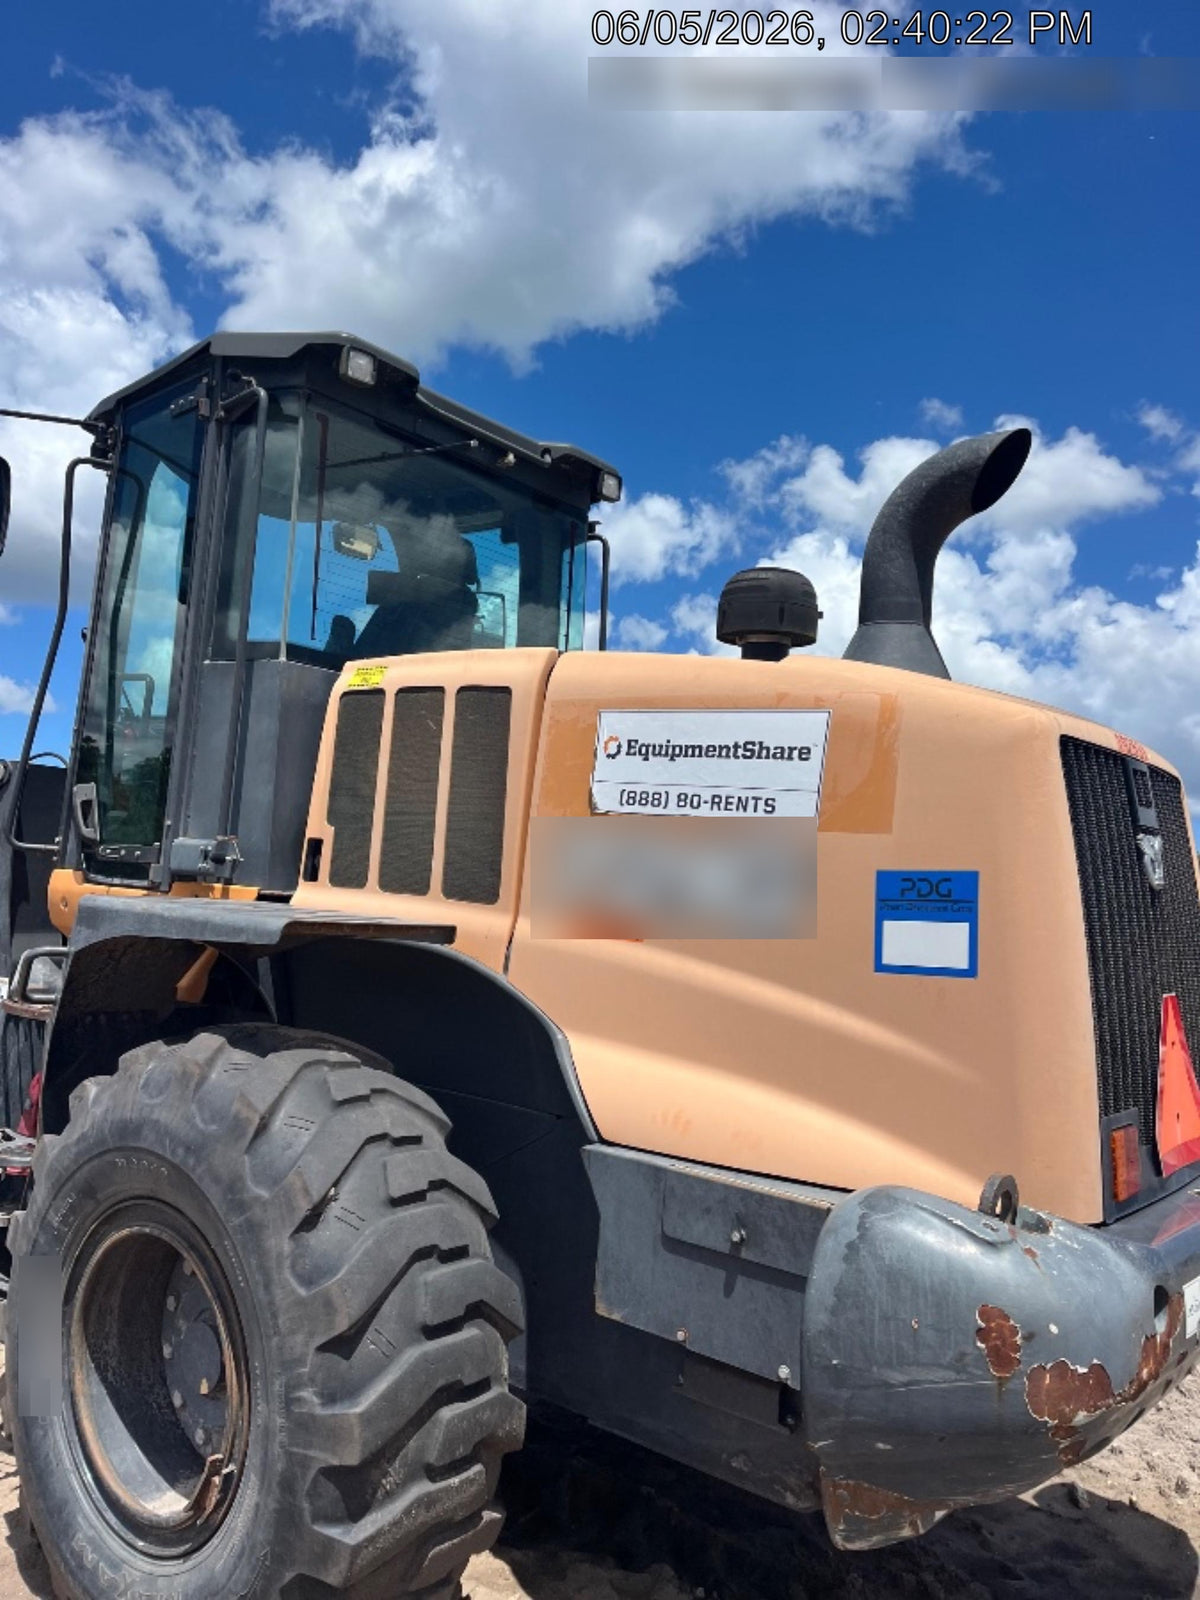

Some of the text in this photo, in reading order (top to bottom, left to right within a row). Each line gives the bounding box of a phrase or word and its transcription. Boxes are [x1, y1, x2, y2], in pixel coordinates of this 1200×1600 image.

[625, 739, 812, 762] EquipmentShare
[619, 789, 777, 814] (888) 80-RENTS
[900, 877, 952, 898] PDG
